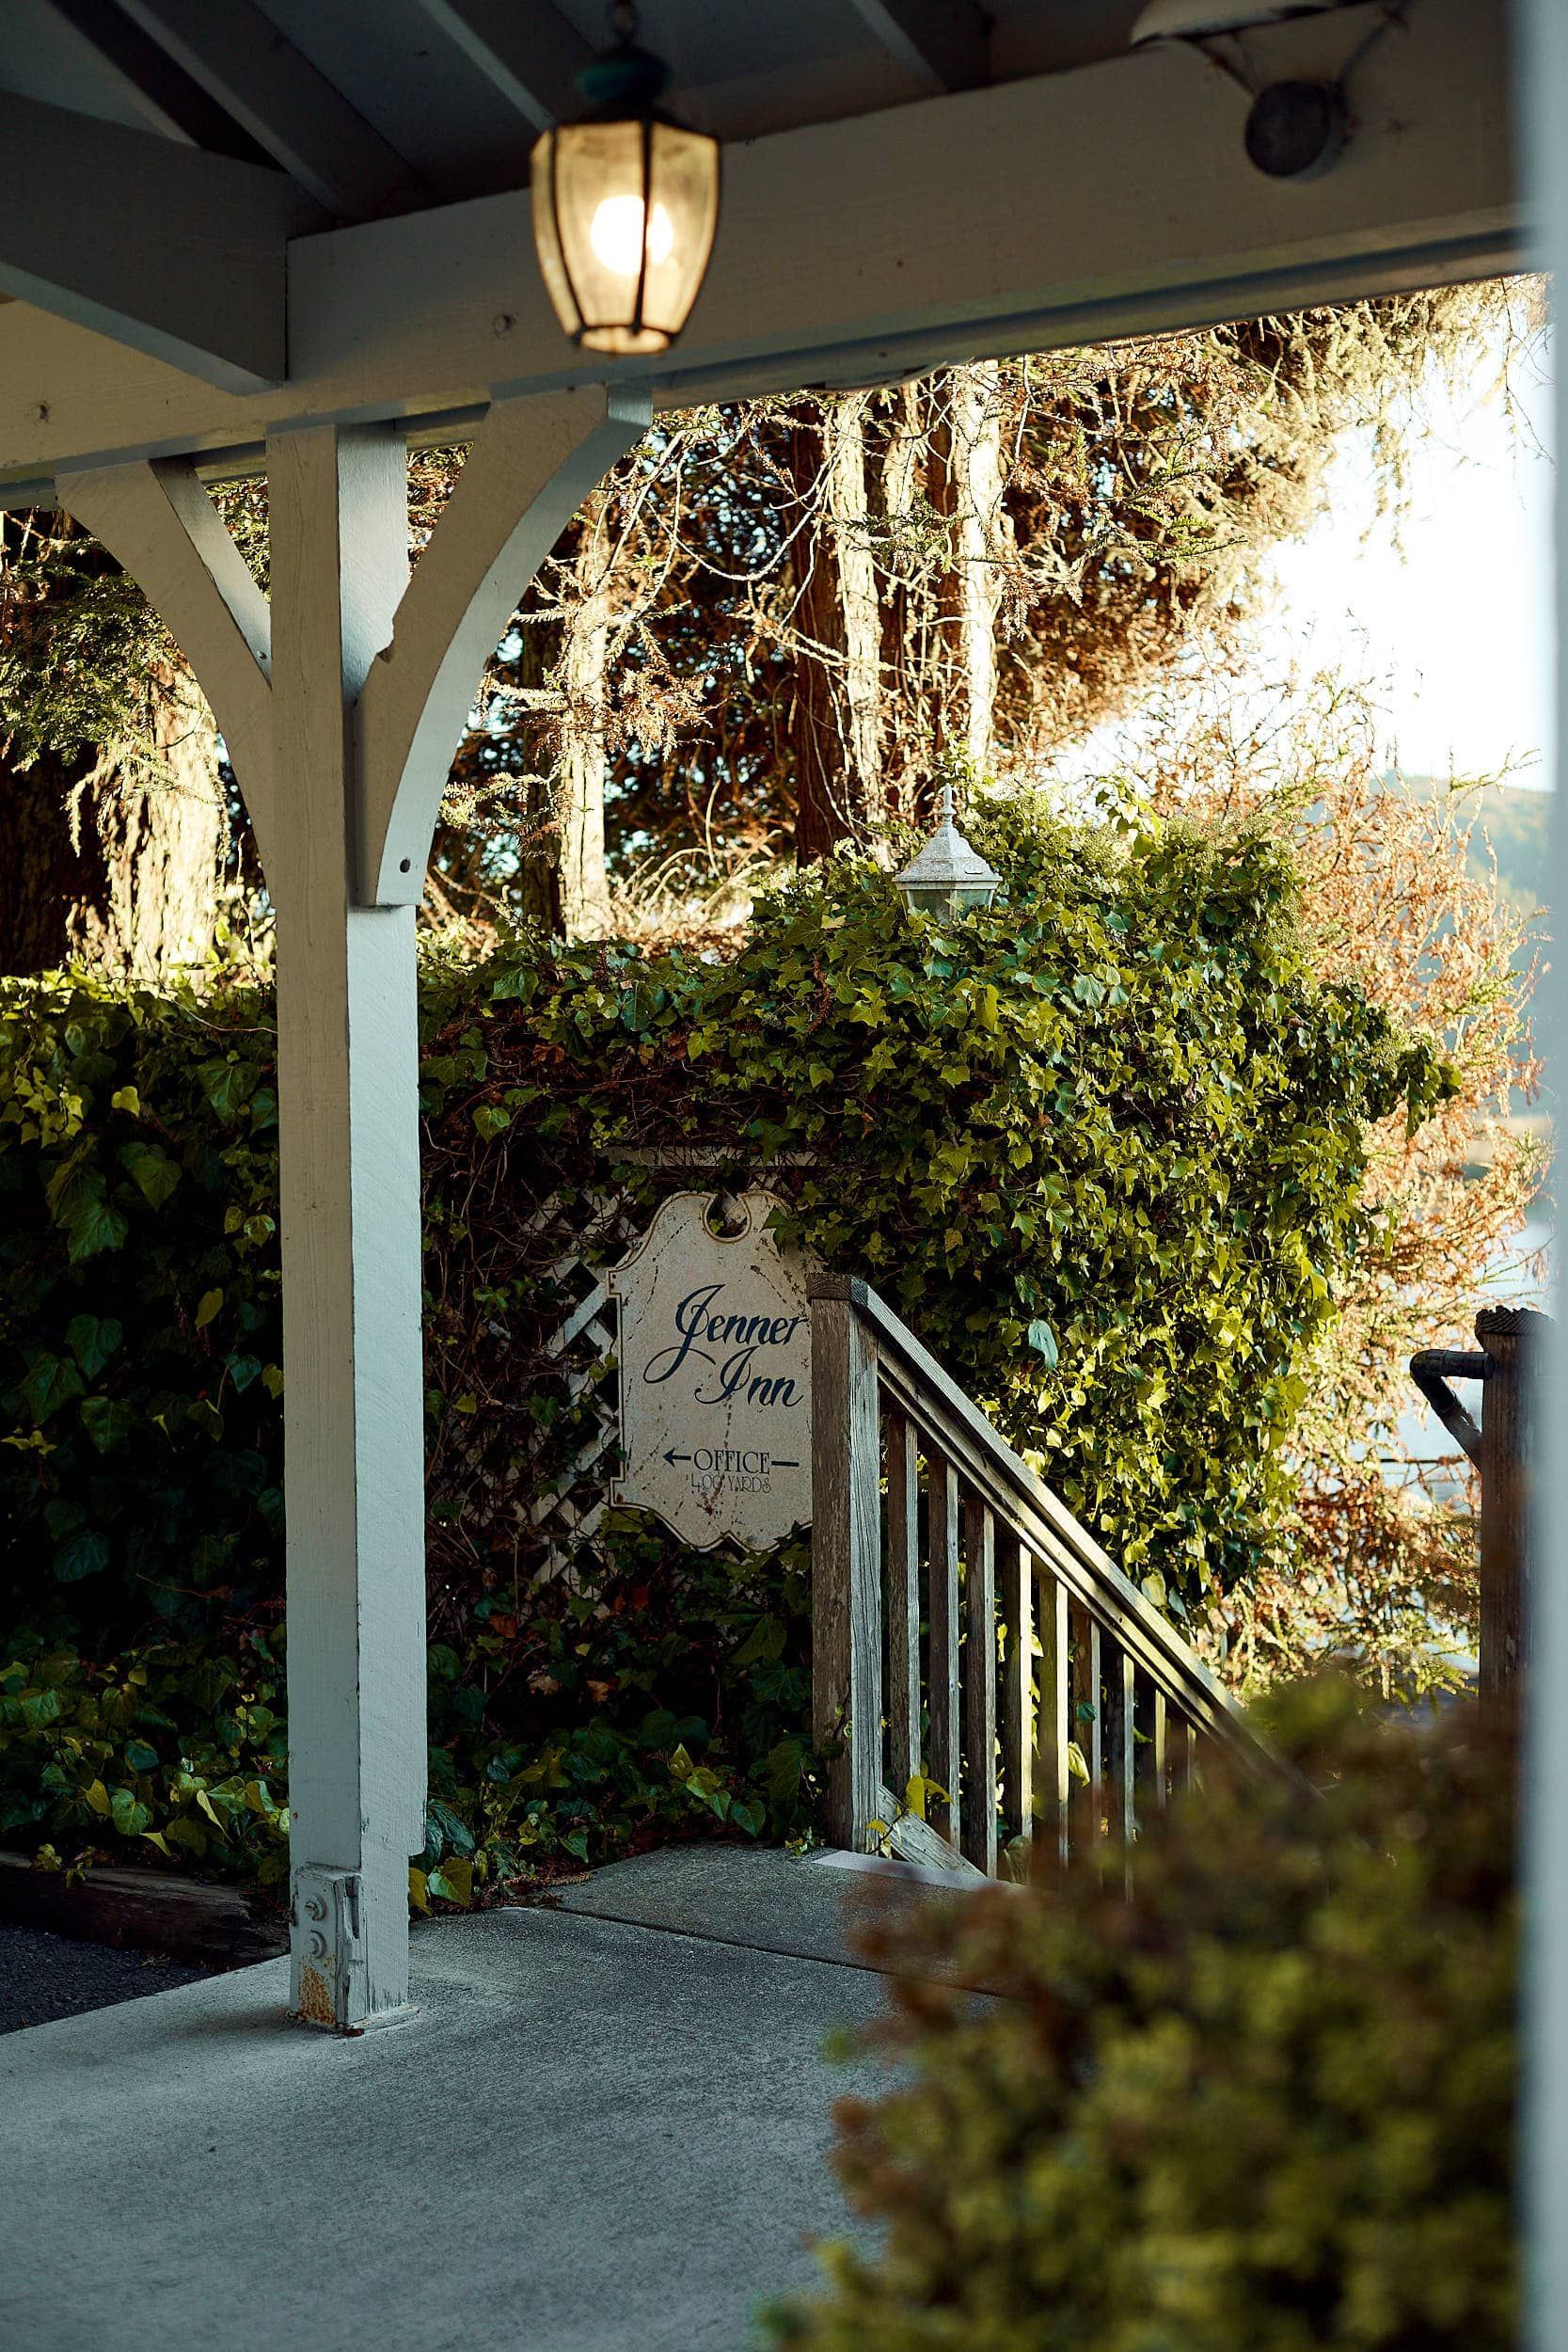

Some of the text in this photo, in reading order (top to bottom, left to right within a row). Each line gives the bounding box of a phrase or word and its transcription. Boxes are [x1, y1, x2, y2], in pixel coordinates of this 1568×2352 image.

[643, 1283, 810, 1384] Jenner
[694, 1344, 804, 1407] Inn
[693, 1448, 770, 1475] OFFICE
[727, 1476, 771, 1494] YARDS
